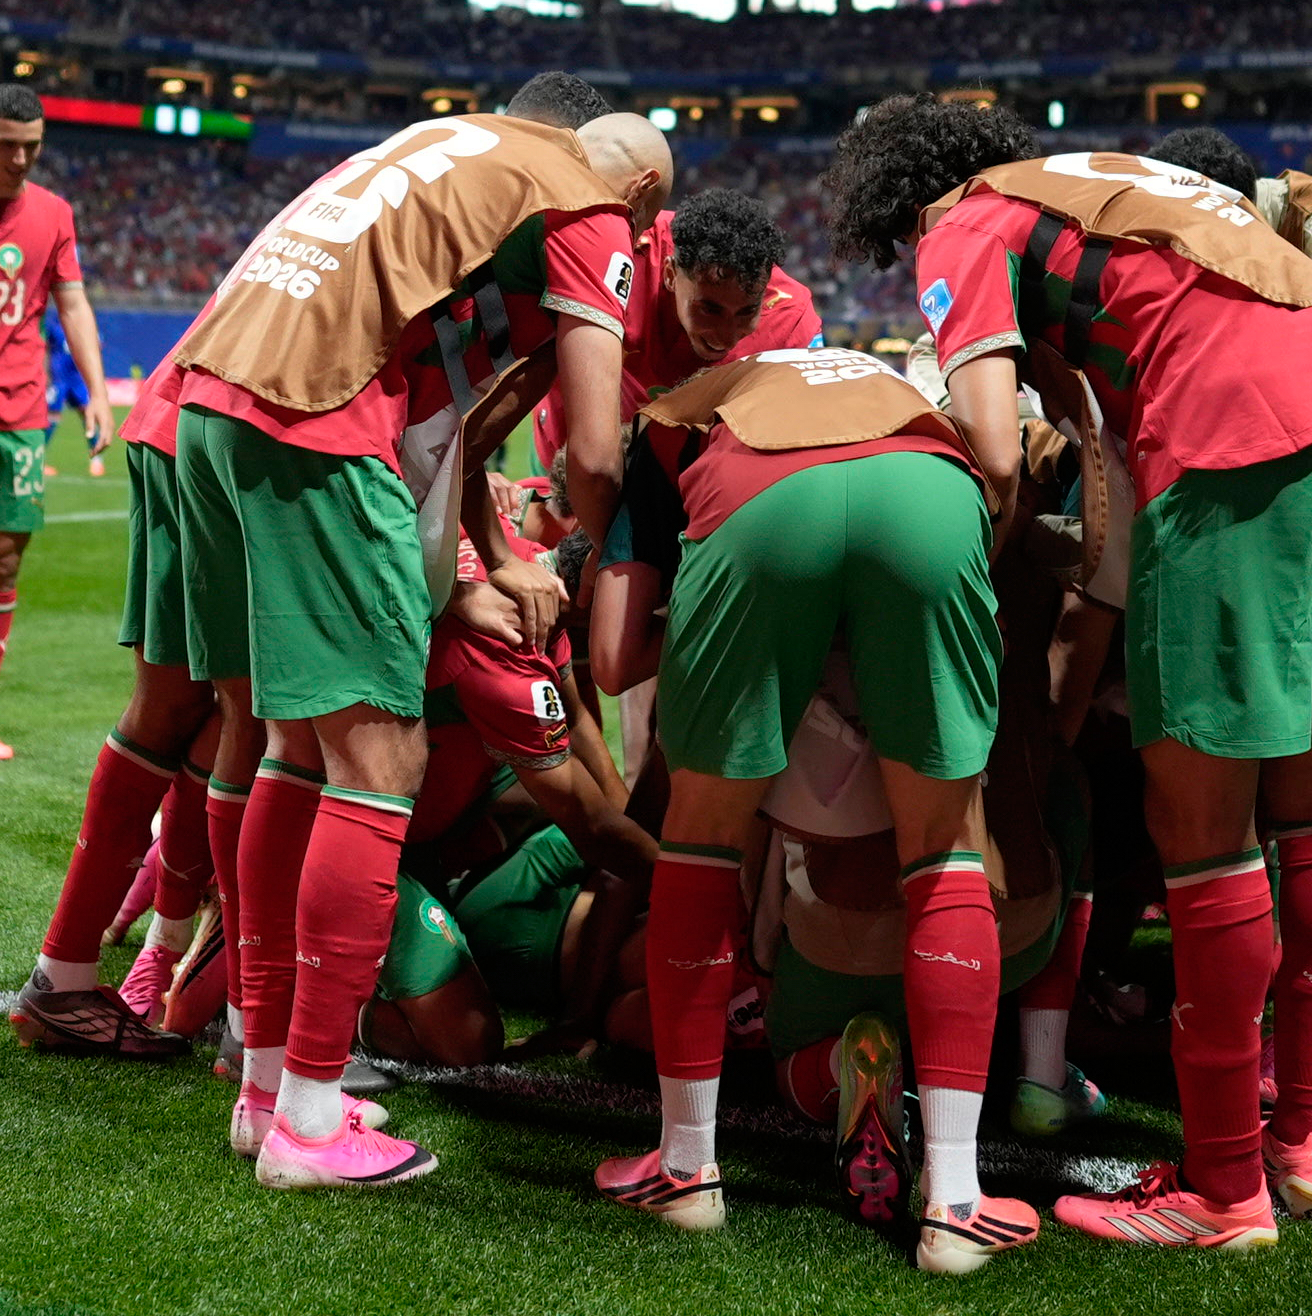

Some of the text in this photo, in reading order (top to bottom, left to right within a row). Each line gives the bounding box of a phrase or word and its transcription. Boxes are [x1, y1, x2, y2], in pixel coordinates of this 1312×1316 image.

[307, 202, 347, 223] FIFA
[300, 245, 340, 271] CUP
[239, 253, 322, 300] 2026
